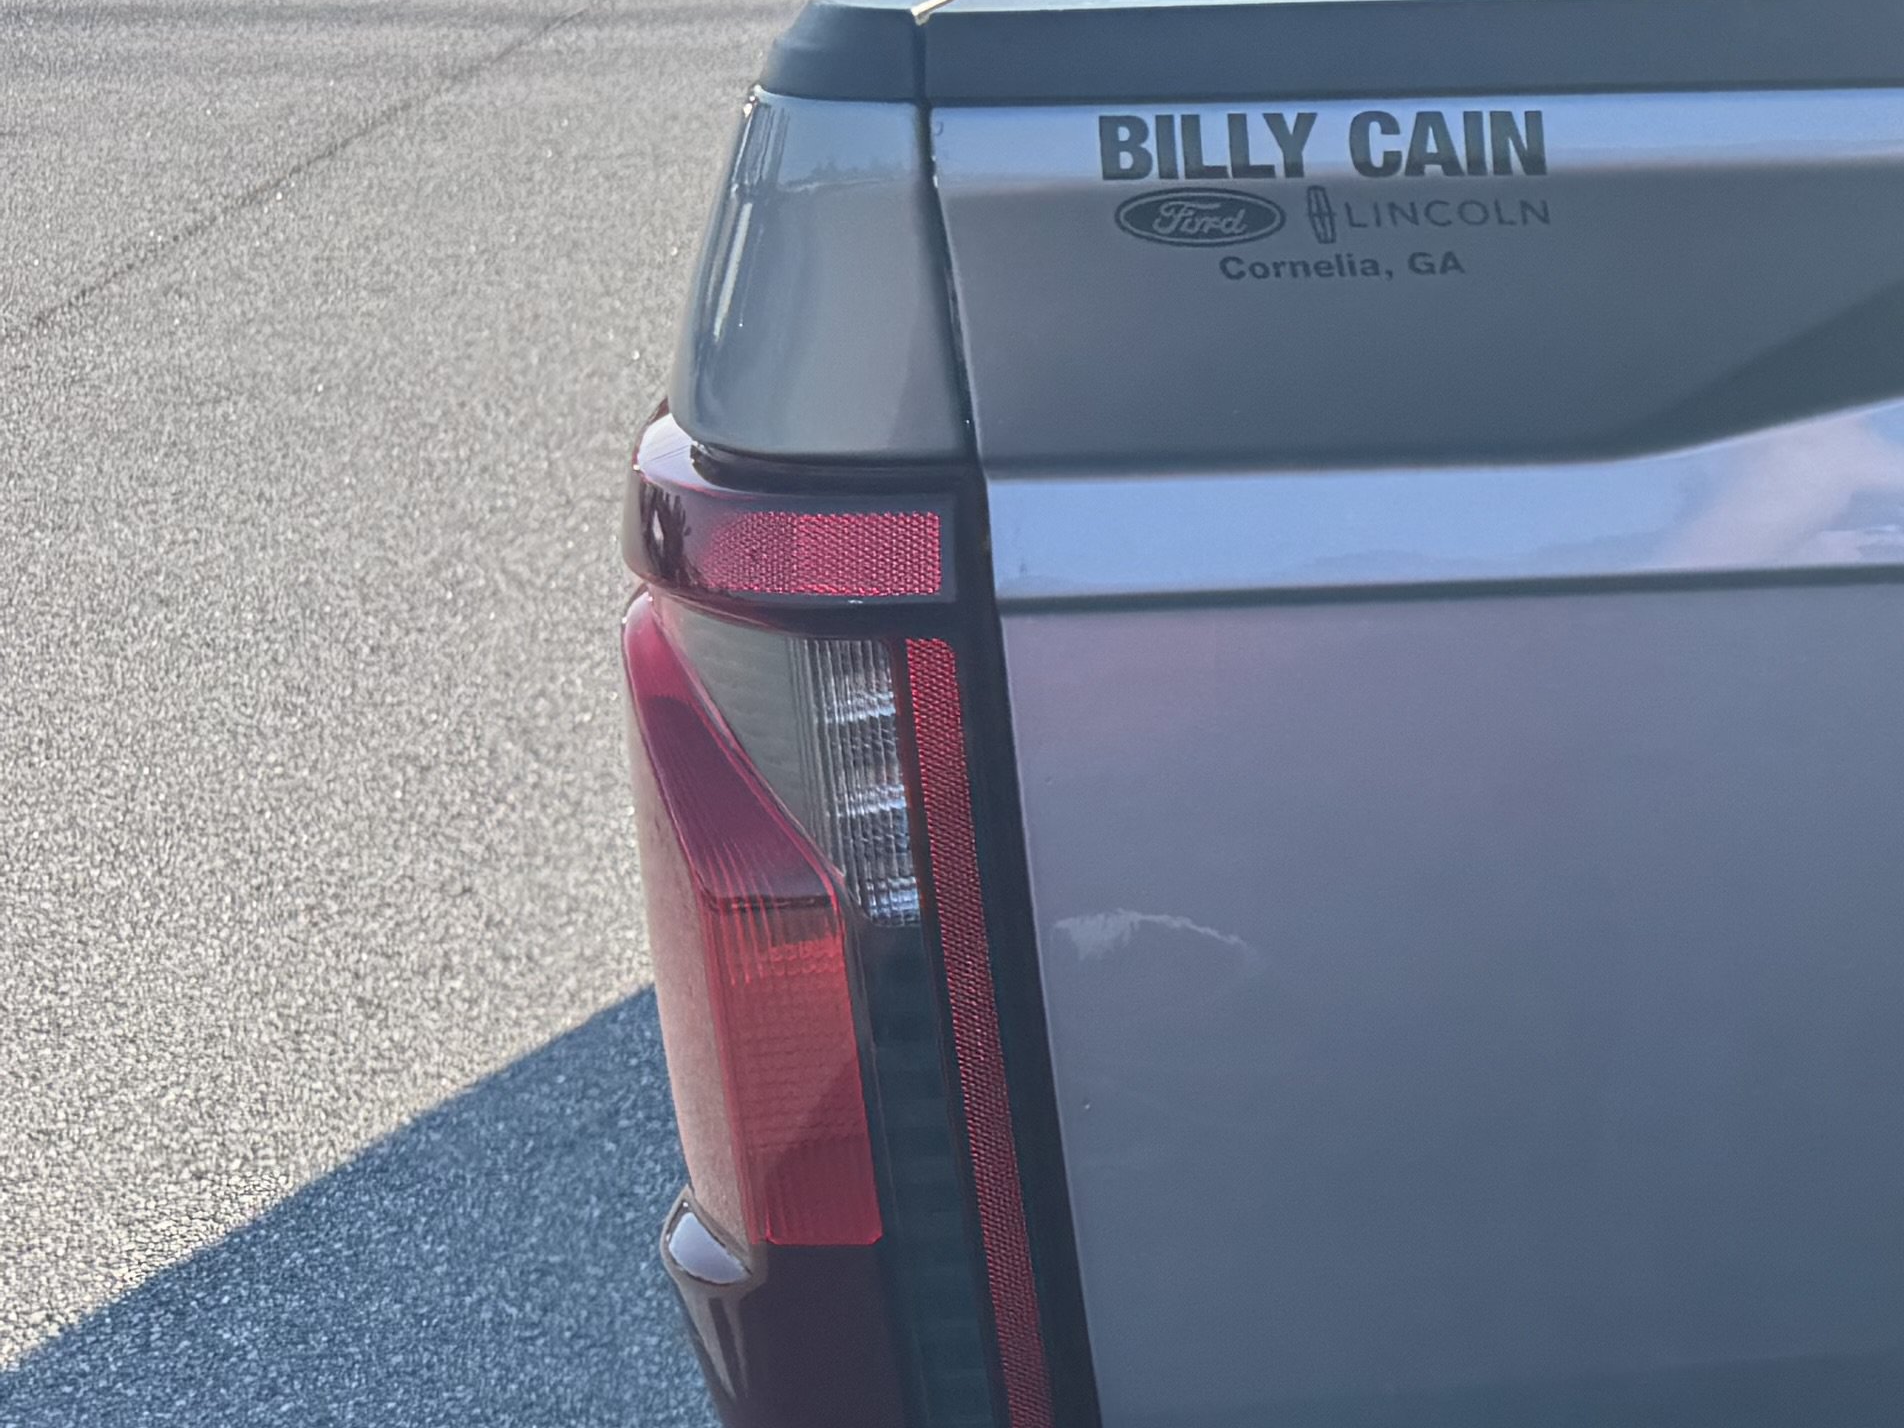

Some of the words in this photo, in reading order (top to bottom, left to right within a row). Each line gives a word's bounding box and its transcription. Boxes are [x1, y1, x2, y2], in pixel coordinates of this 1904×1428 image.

[1098, 111, 1318, 181] BILLY
[1348, 110, 1548, 179] CAIN
[1151, 200, 1248, 237] Ford
[1343, 198, 1551, 230] LINCOLN
[1218, 254, 1394, 282] Cornelia,
[1407, 250, 1466, 276] GA
